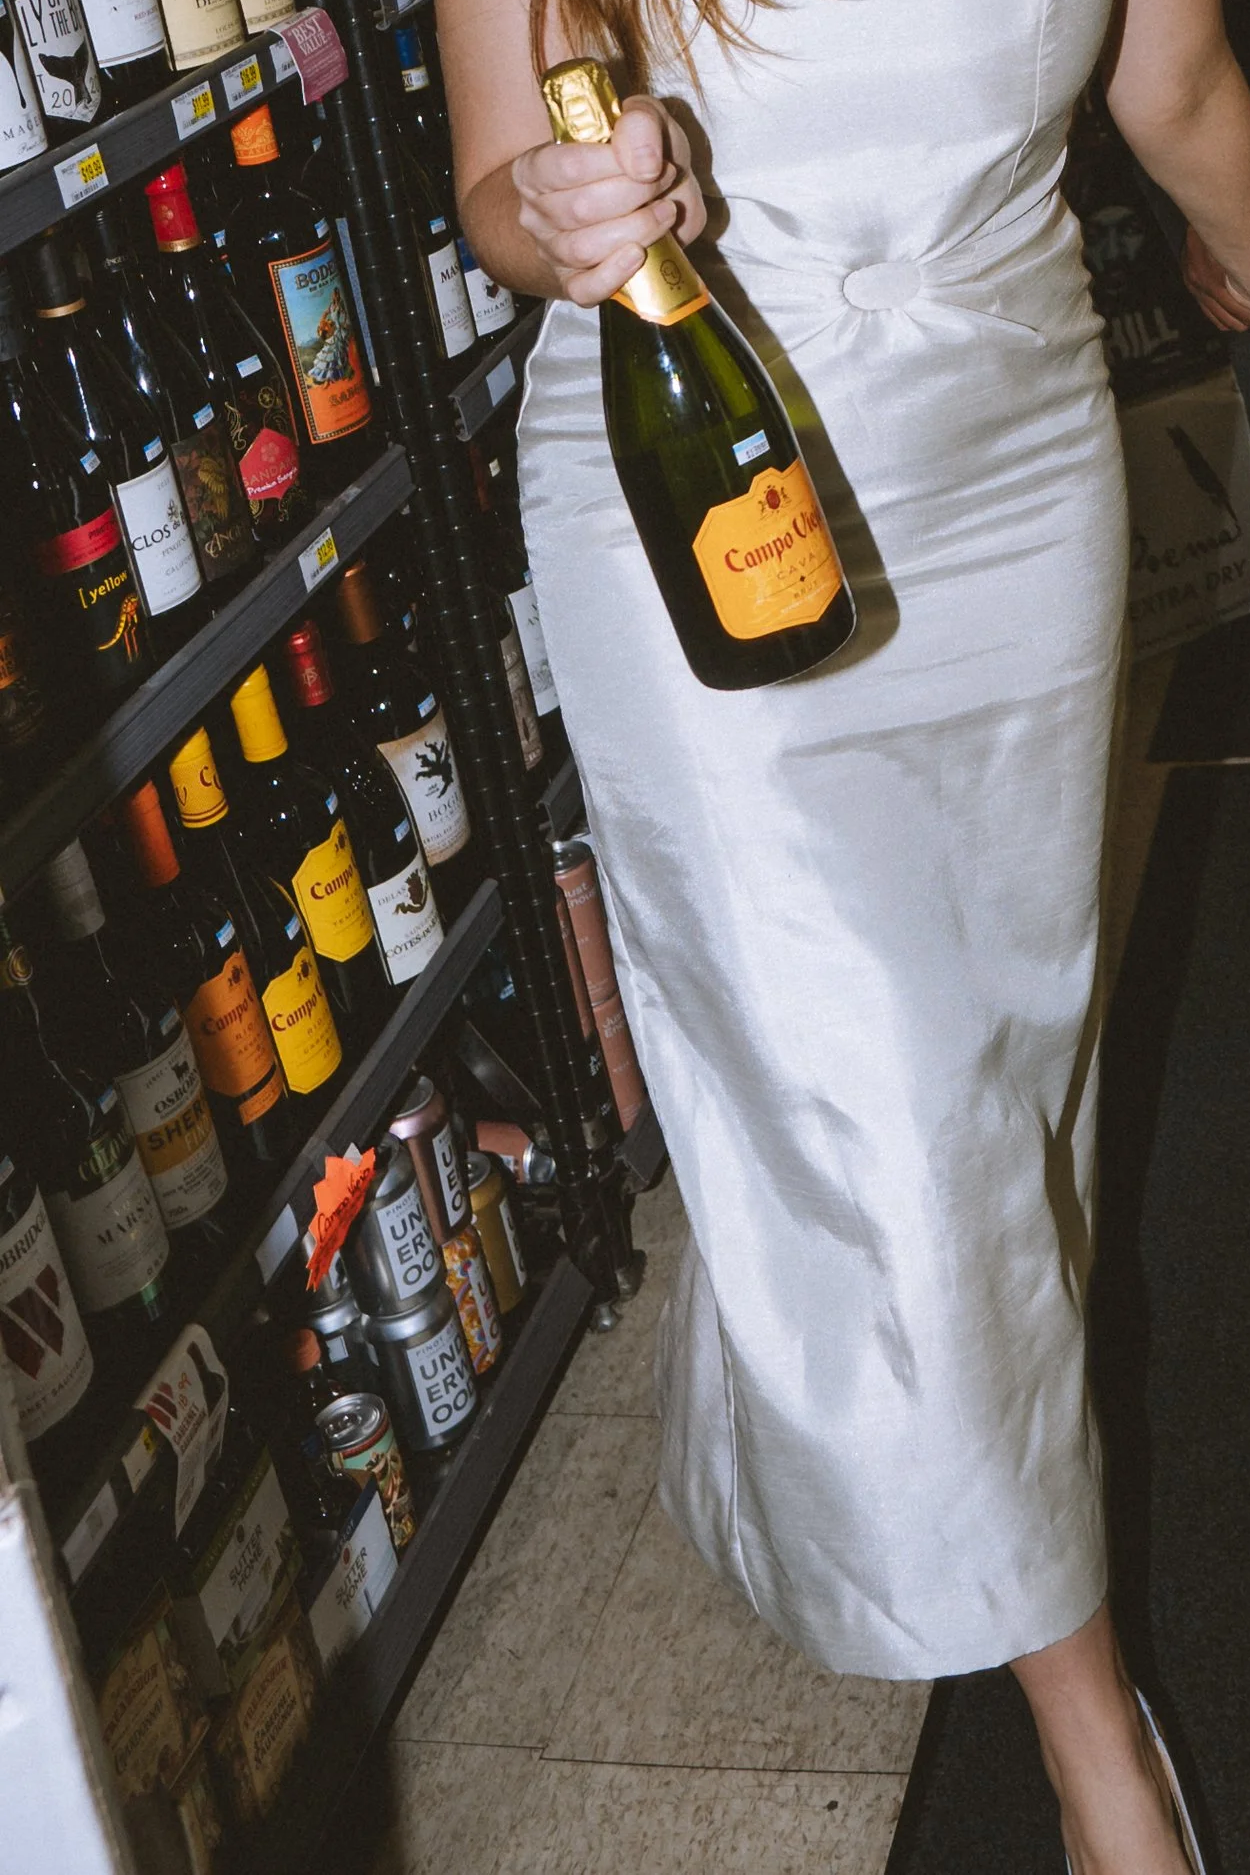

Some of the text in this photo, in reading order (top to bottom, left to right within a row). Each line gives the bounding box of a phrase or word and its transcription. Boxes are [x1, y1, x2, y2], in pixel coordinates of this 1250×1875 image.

[49, 8, 72, 39] THE
[132, 523, 171, 552] CLOS
[724, 530, 794, 573] Campo
[776, 551, 816, 581] CAVA
[1206, 557, 1249, 593] DRY
[271, 994, 318, 1033] Campo
[230, 1523, 264, 1587] SUTTER
[335, 1545, 368, 1606] SUTTER
[343, 1563, 369, 1611] HOME
